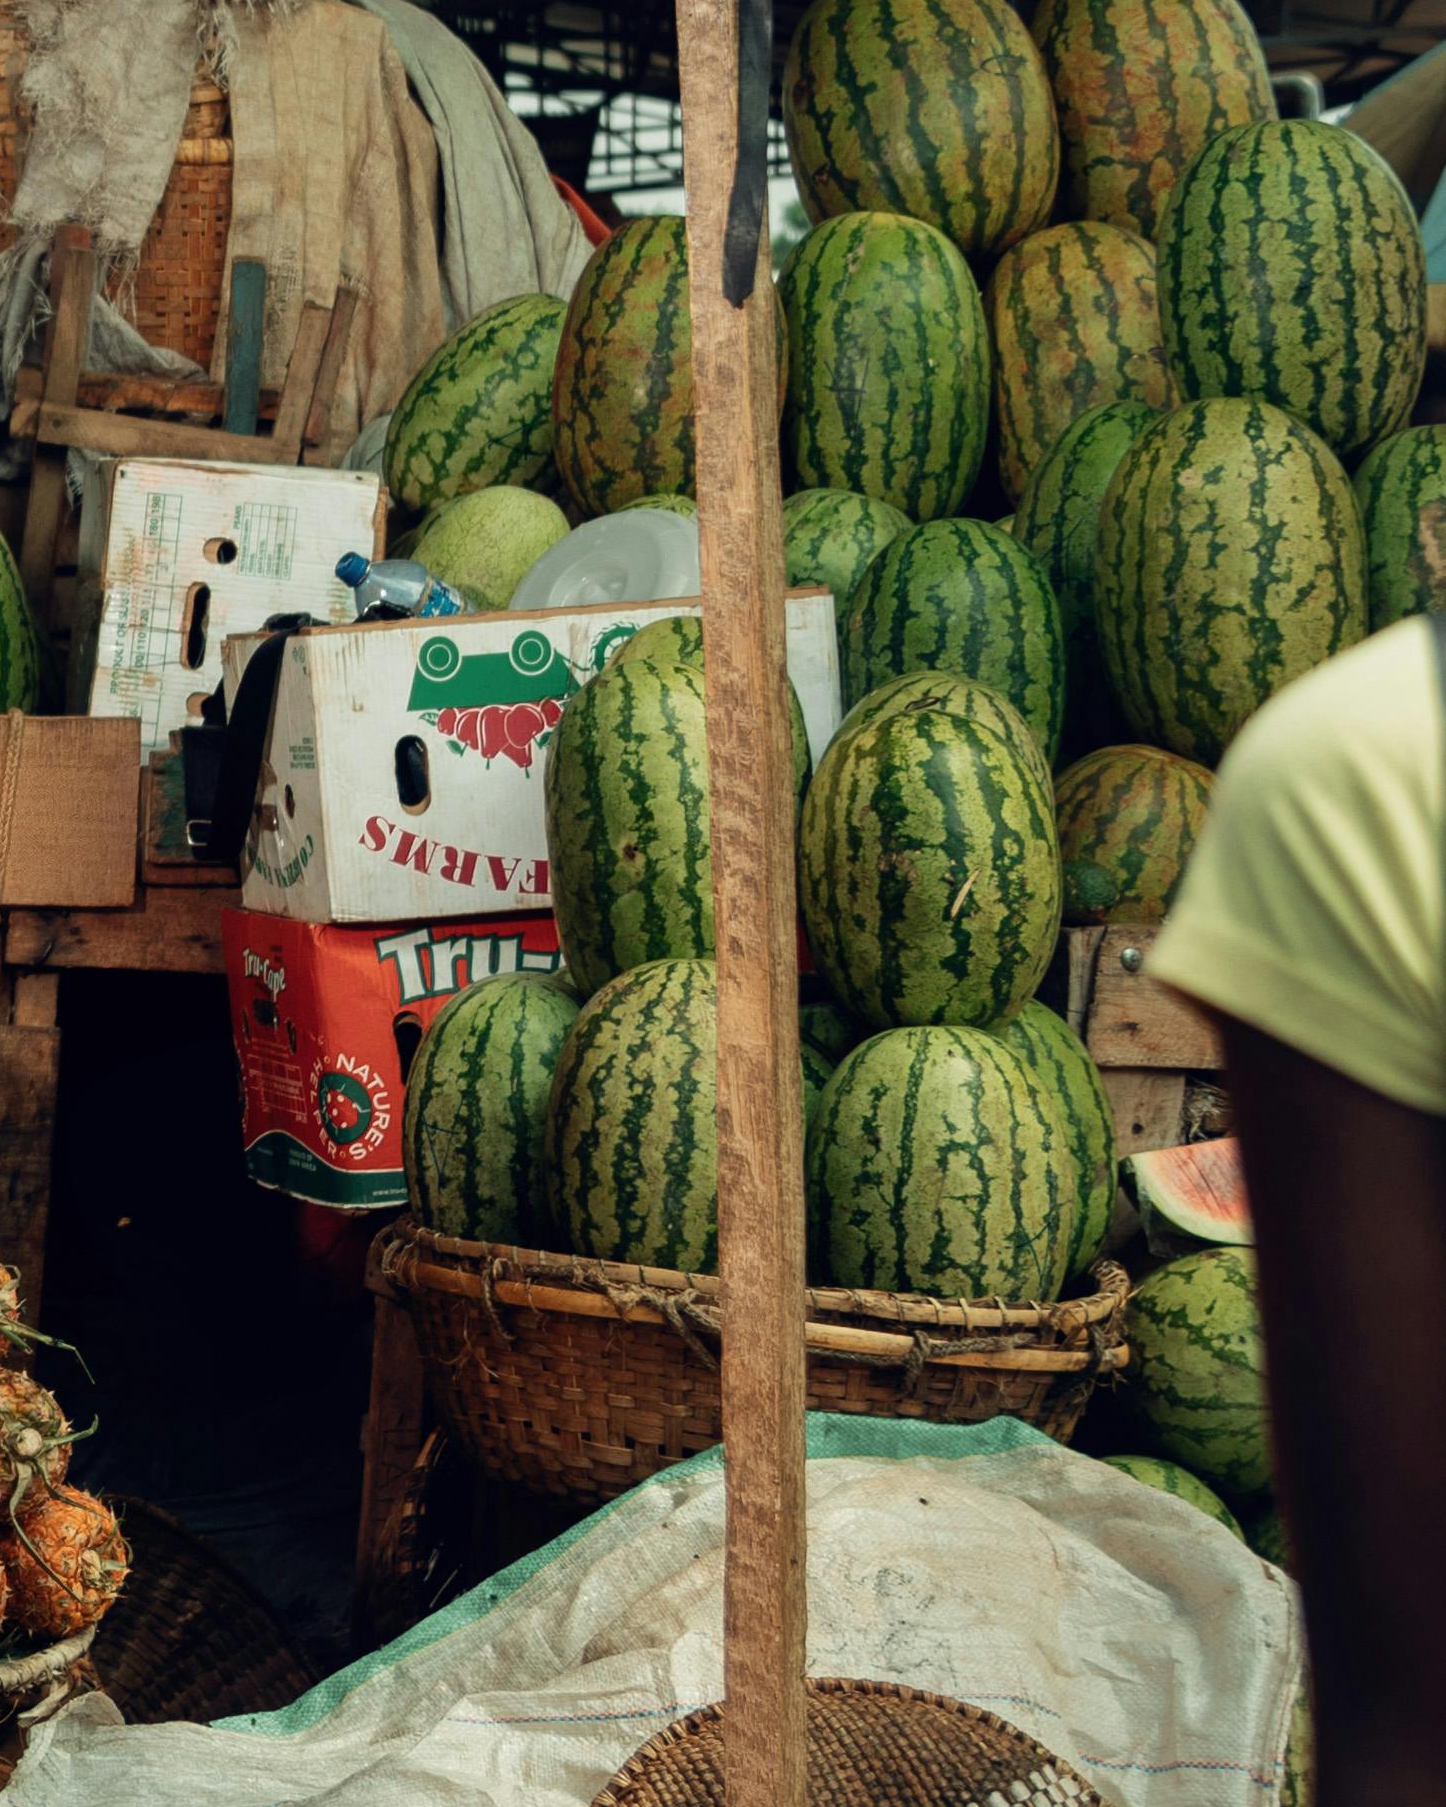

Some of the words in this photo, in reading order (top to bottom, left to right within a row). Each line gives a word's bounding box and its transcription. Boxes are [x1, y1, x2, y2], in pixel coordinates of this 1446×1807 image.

[150, 518, 159, 536] 180
[358, 815, 549, 894] FARMS
[336, 1052, 390, 1161] NATURE'S
